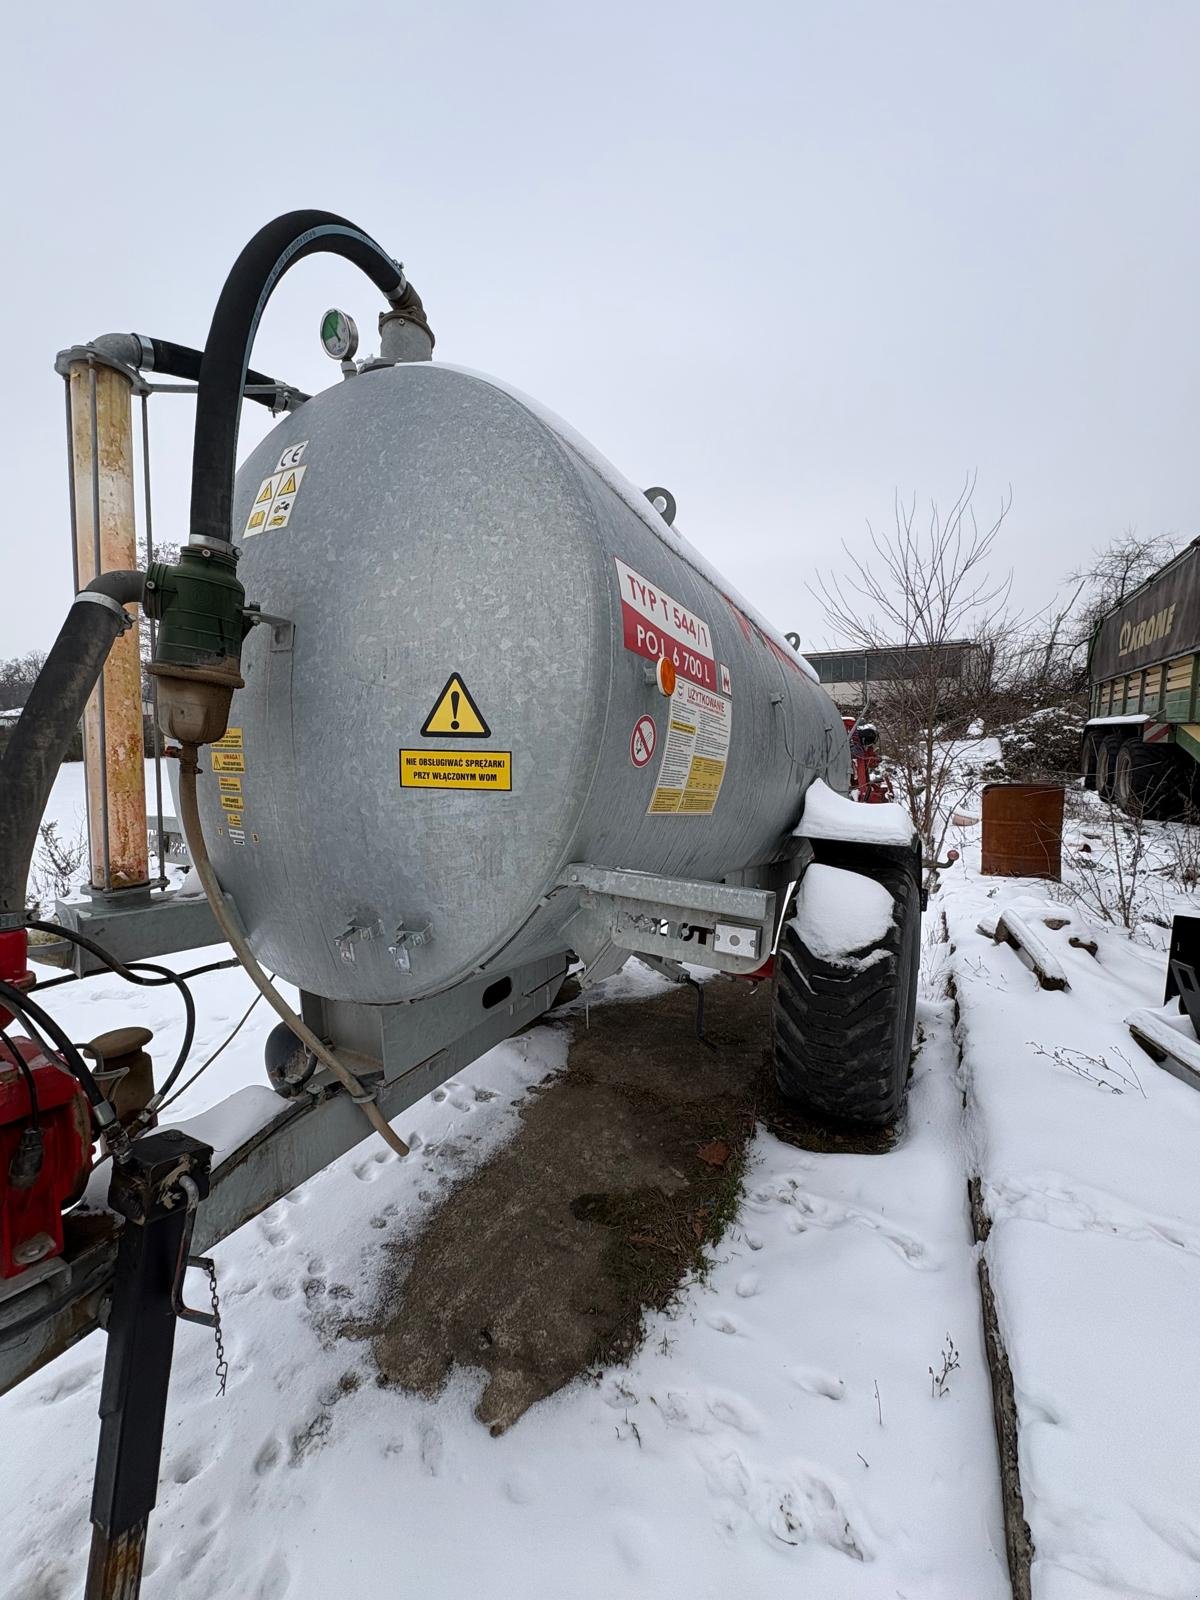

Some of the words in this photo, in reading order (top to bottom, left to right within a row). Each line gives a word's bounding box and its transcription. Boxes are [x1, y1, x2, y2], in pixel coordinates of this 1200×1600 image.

[281, 445, 304, 467] CE
[627, 574, 657, 612] TYP
[660, 598, 668, 622] T
[673, 607, 708, 648] 544/1
[1128, 603, 1176, 653] KRONE
[673, 646, 680, 667] 6
[682, 651, 702, 679] 700
[704, 664, 710, 684] L
[406, 758, 416, 766] NIE
[418, 758, 463, 768] OBSŁUGIWAĆ
[465, 759, 505, 770] SPRĘŻARKI
[413, 771, 430, 780] PRZY
[432, 772, 476, 782] WŁĄCZONYM
[478, 773, 497, 782] WOM
